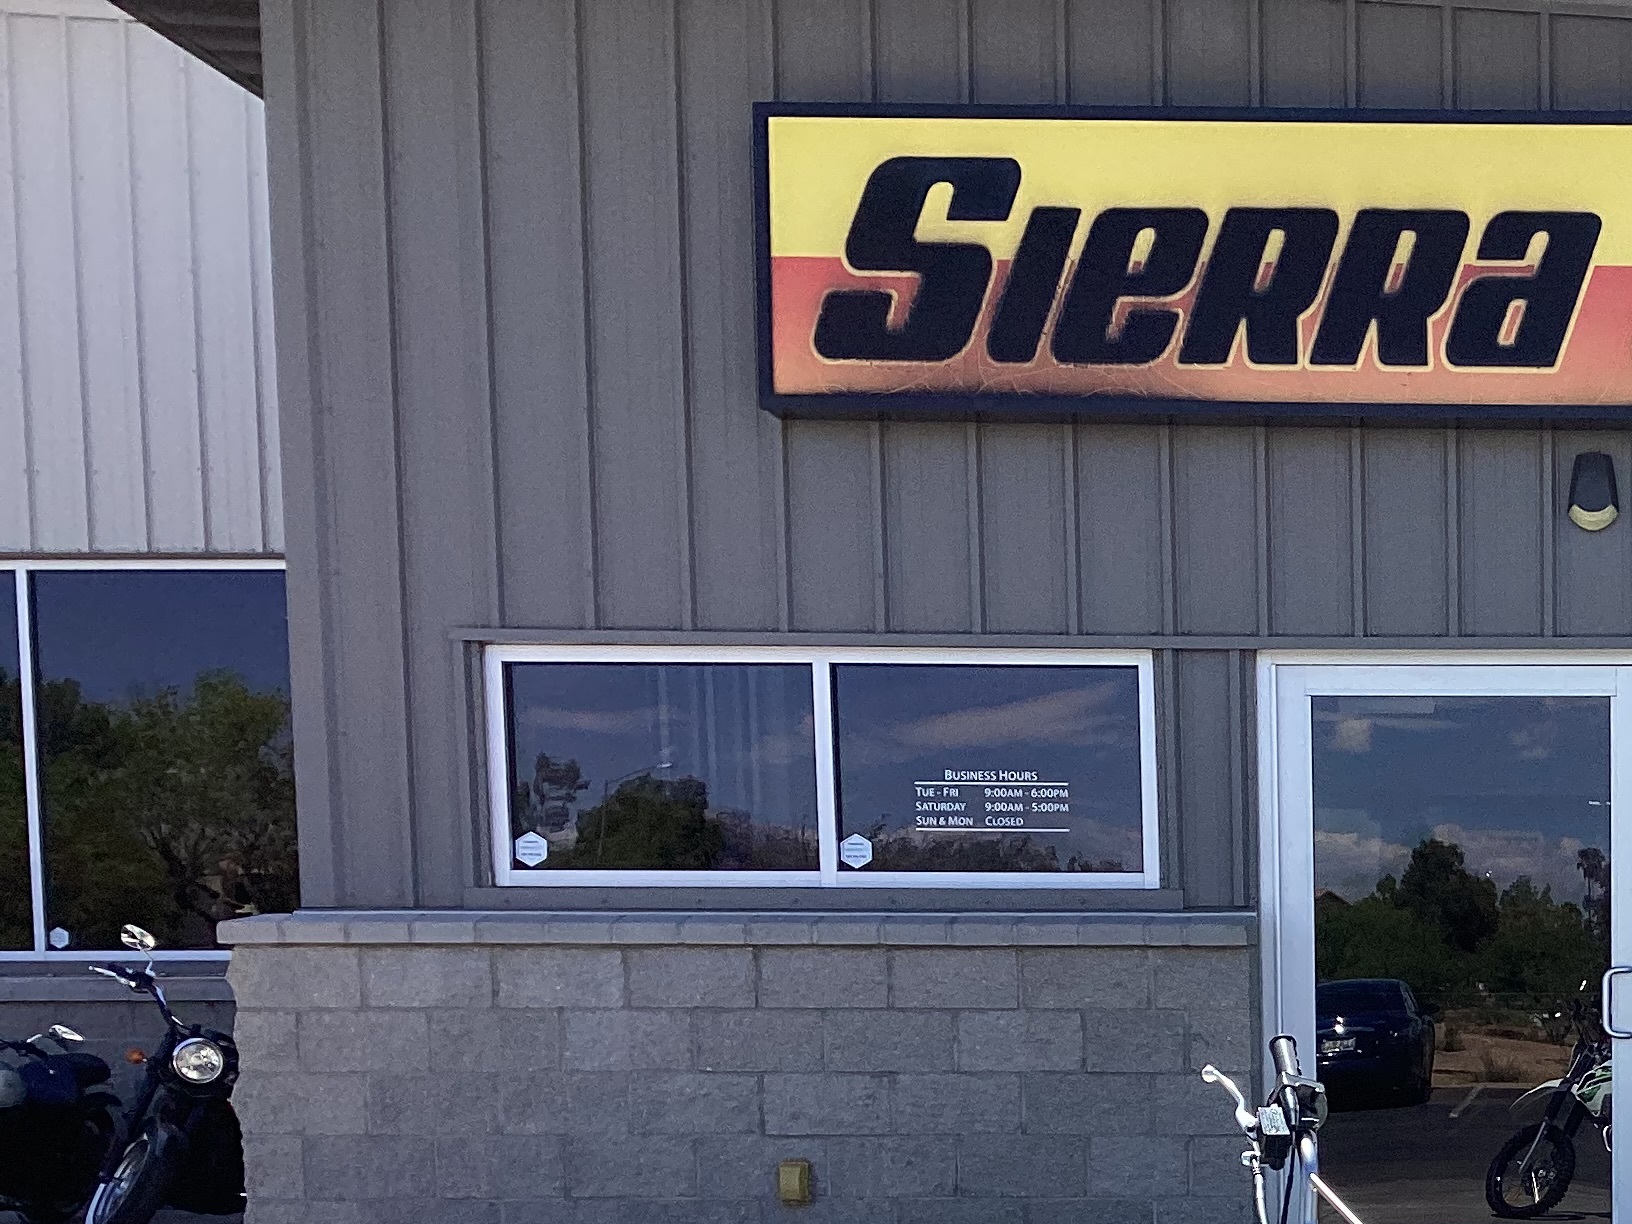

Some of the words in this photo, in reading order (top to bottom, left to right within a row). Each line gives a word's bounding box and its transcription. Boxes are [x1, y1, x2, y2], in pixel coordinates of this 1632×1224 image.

[944, 769, 997, 781] BUSINESS
[999, 769, 1038, 781] HOURS
[915, 786, 936, 798] TUE
[943, 786, 959, 798] FRI
[984, 787, 1023, 798] 9:00AM
[1030, 787, 1069, 798] 6:00PM
[915, 801, 967, 812] SATURDAY
[984, 802, 1024, 812] 9:00AM
[1031, 802, 1069, 812] 5:00PM
[915, 816, 937, 826] SUN
[947, 816, 974, 826] MON
[985, 816, 1024, 826] CLOSED
